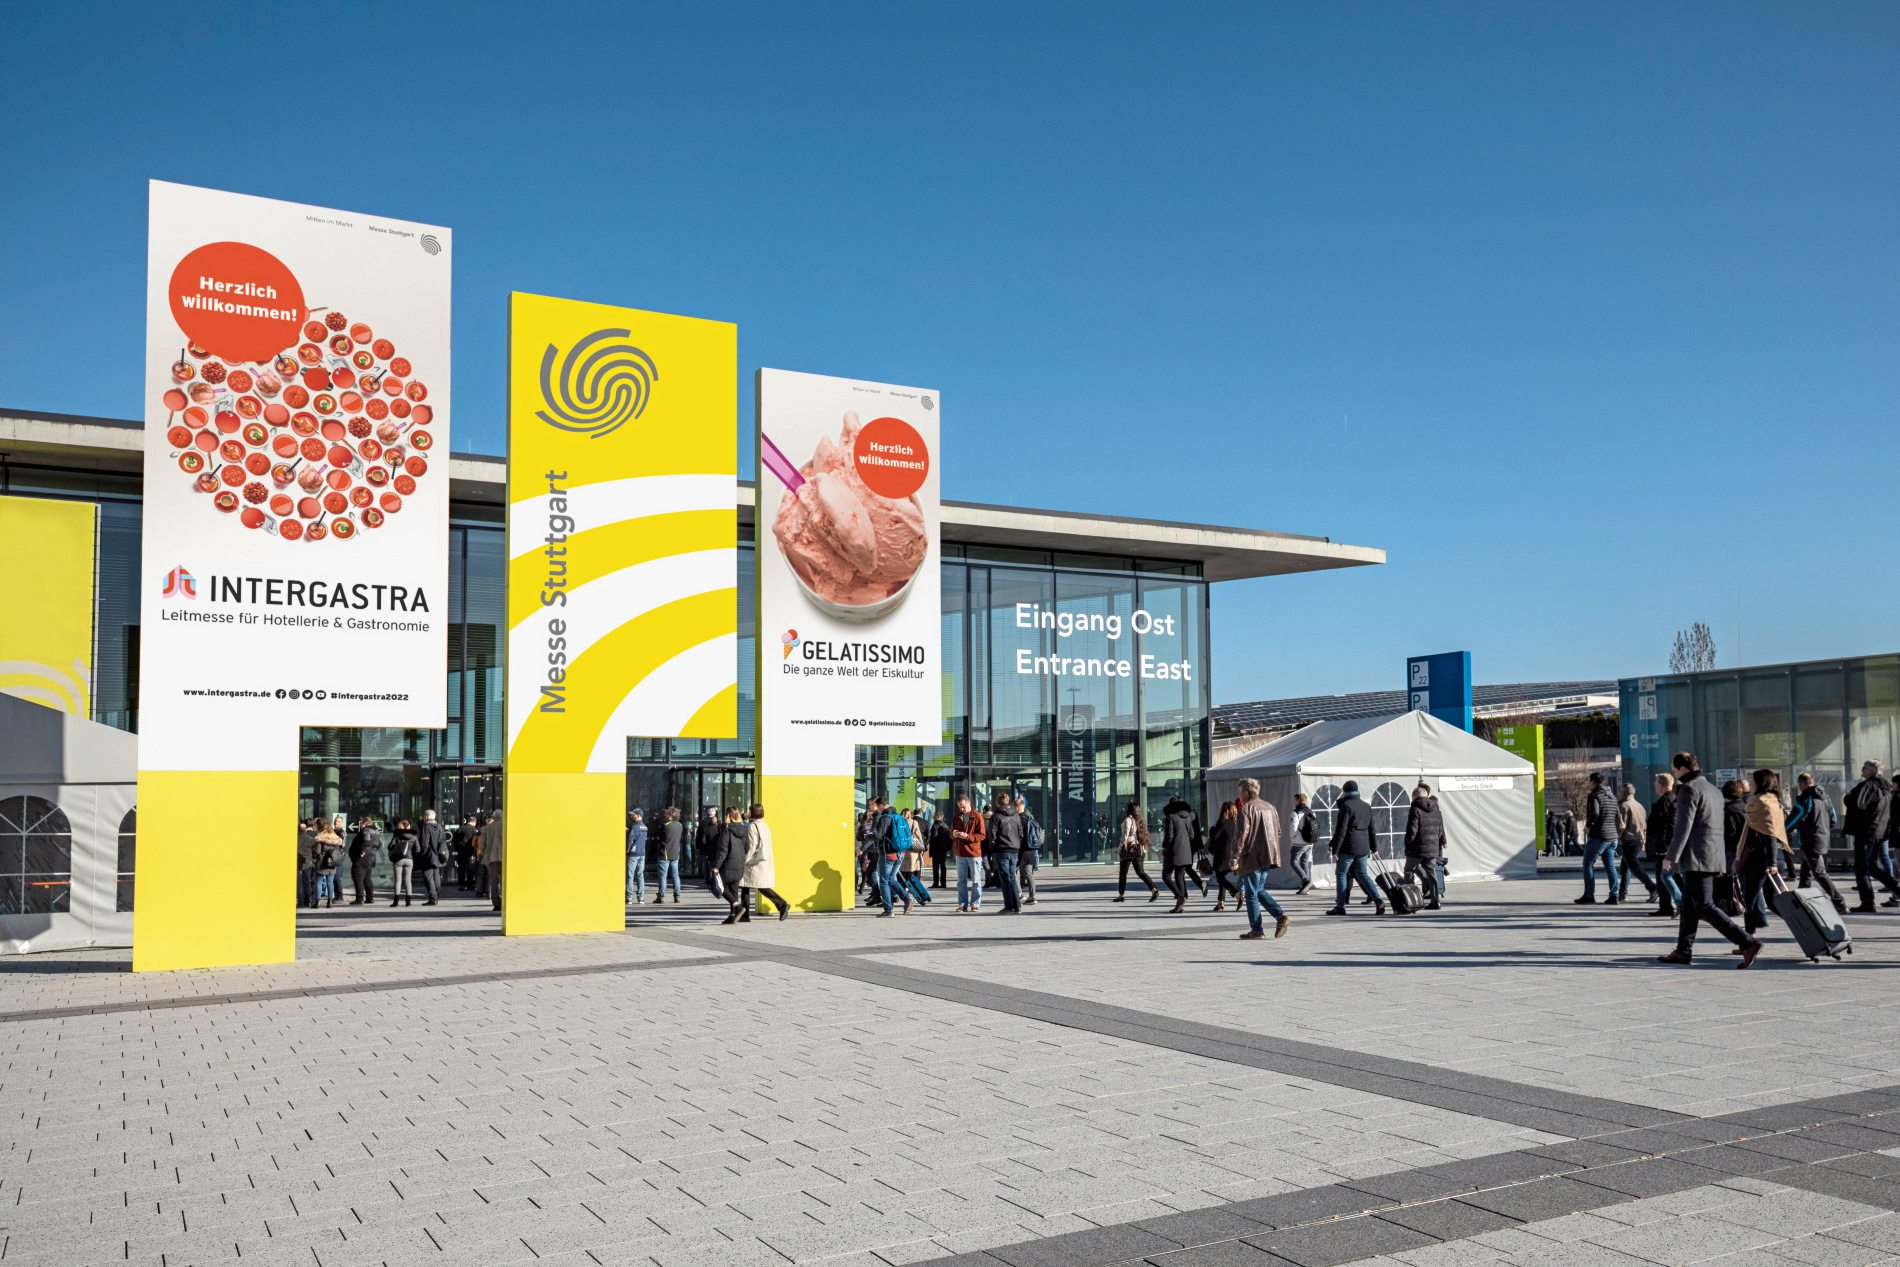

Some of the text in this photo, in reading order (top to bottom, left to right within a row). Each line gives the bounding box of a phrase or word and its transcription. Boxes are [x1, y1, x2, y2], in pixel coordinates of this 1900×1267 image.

[305, 215, 326, 224] Mitten
[335, 219, 353, 228] Markt
[369, 225, 414, 238] Messe Stuttgart
[200, 276, 277, 299] Herzlich
[181, 294, 297, 322] willkommen!
[870, 441, 913, 456] Herzlich
[859, 454, 925, 470] willkommen!
[210, 575, 430, 613] INTERGASTRA
[540, 469, 575, 712] Messe Stuttgart
[161, 609, 430, 632] Leitmesse für Hotellerie & Gastronomie
[1016, 602, 1175, 640] Eingang Ost
[803, 641, 925, 665] GELATISSIMO
[783, 664, 925, 679] Die ganze Welt der Eiskultur
[1016, 648, 1192, 681] Entrance East
[1412, 664, 1428, 685] P 22
[183, 688, 409, 701] www.intergastra.de #intergastra2022
[1413, 694, 1421, 710] P
[790, 718, 842, 726] www.gelatissimo.de
[1069, 740, 1084, 801] Allianz
